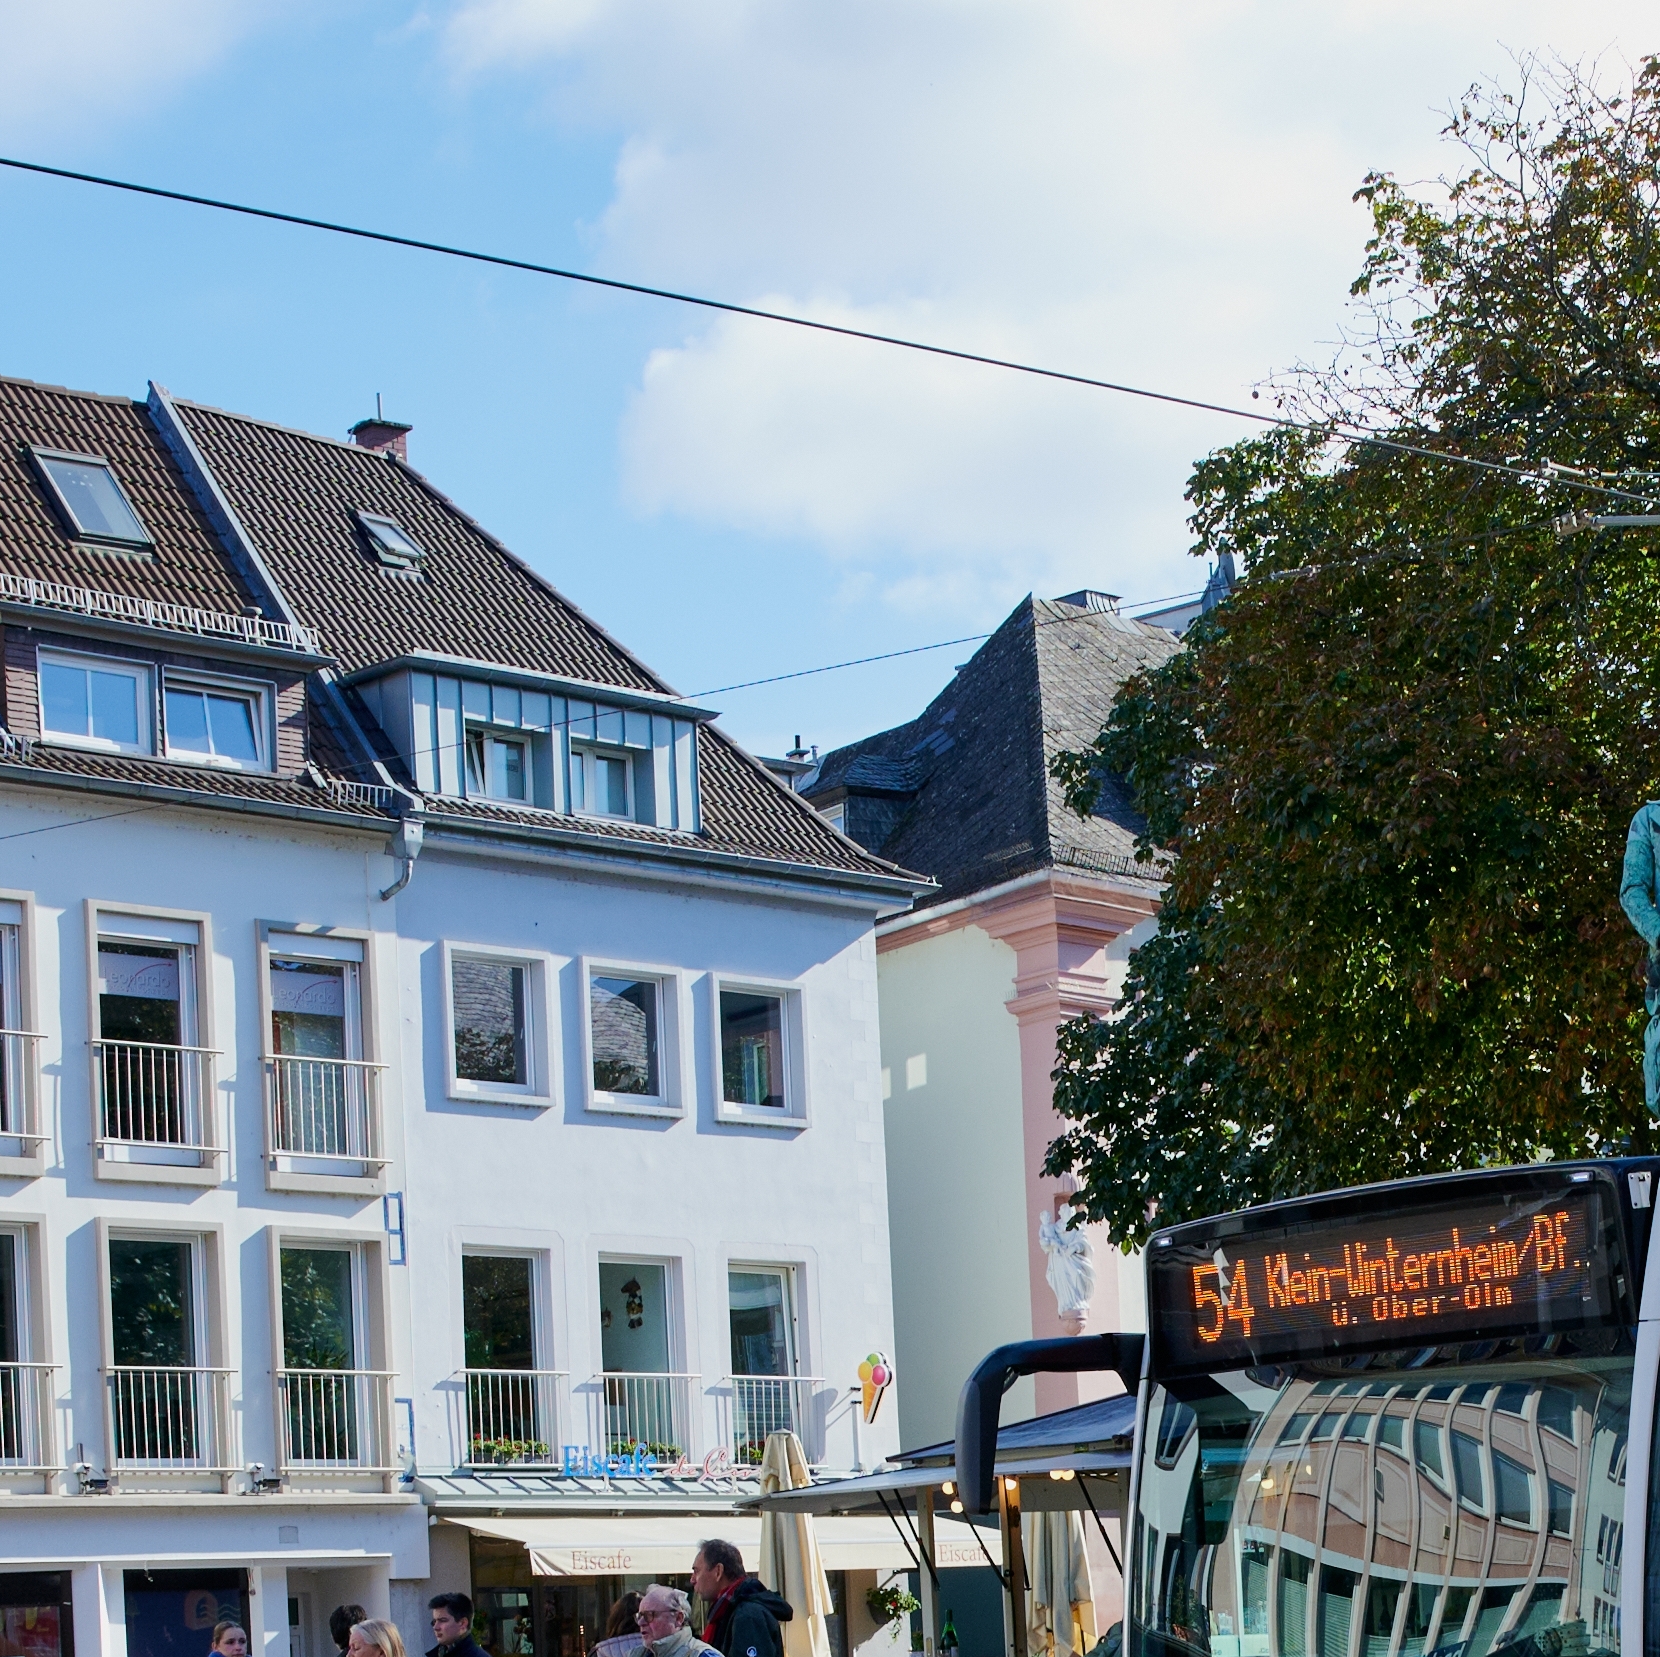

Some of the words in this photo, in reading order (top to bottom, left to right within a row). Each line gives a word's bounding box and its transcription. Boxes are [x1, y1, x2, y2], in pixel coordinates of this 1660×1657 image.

[1264, 1211, 1581, 1309] Klein-Winternheim/Bf.
[1192, 1259, 1255, 1343] 54
[1372, 1283, 1513, 1322] Ober-Olm
[571, 1548, 632, 1570] Eiscafe
